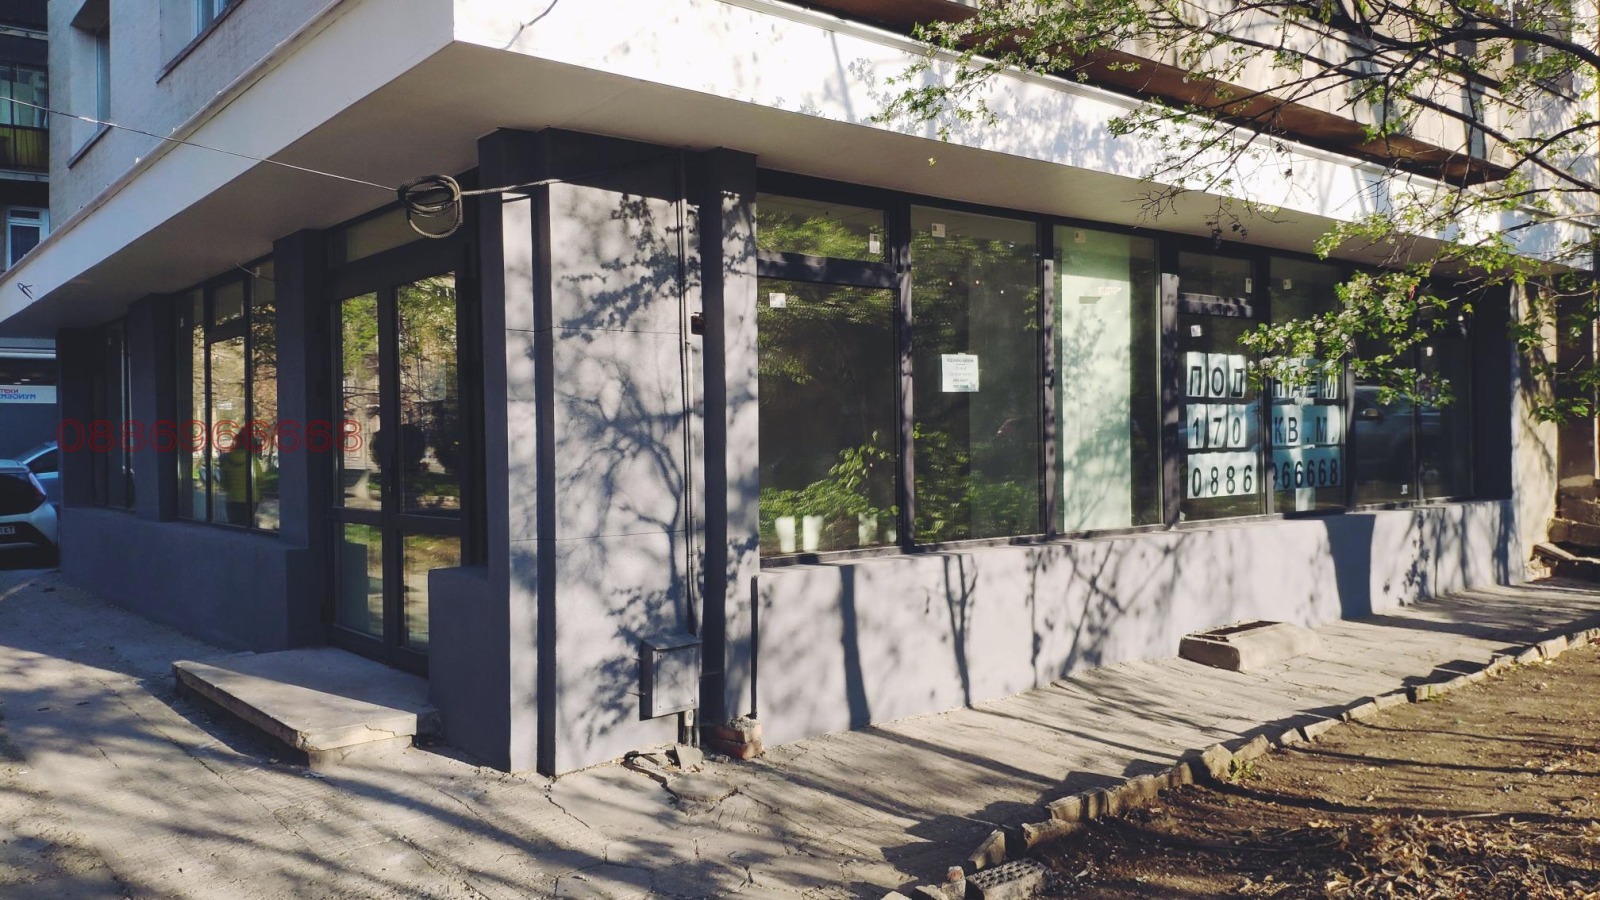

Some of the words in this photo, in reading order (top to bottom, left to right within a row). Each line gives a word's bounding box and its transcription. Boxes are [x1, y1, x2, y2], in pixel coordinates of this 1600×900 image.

[1189, 365, 1244, 398] ПОД
[1192, 416, 1241, 446] 170
[1191, 464, 1253, 497] 0886
